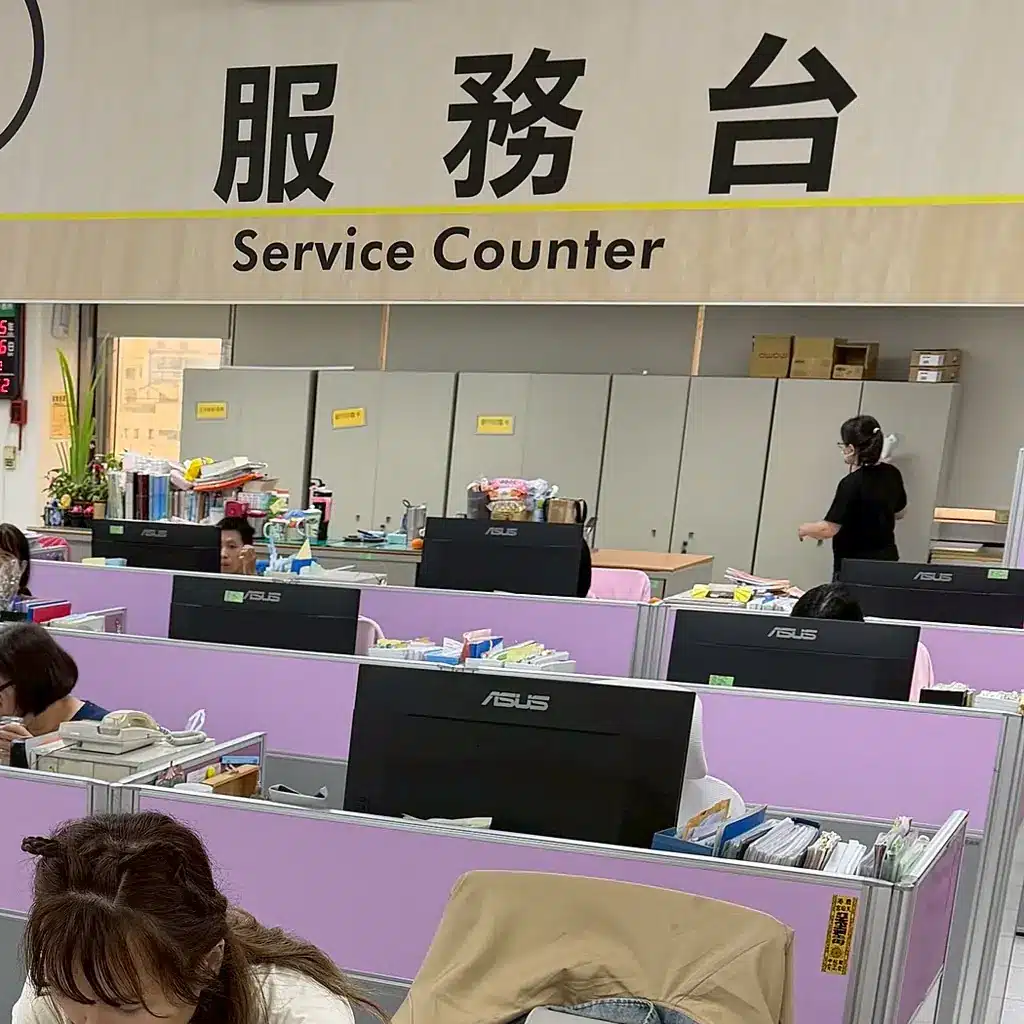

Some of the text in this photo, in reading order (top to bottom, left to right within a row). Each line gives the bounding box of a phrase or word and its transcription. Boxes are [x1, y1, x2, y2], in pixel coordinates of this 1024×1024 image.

[213, 33, 857, 203] 服務台
[233, 227, 665, 272] Service Counter
[485, 527, 518, 537] ASUS
[913, 571, 953, 582] ASUS
[243, 590, 281, 602] ASUS
[767, 626, 818, 641] ASUS
[481, 690, 550, 712] ASUS
